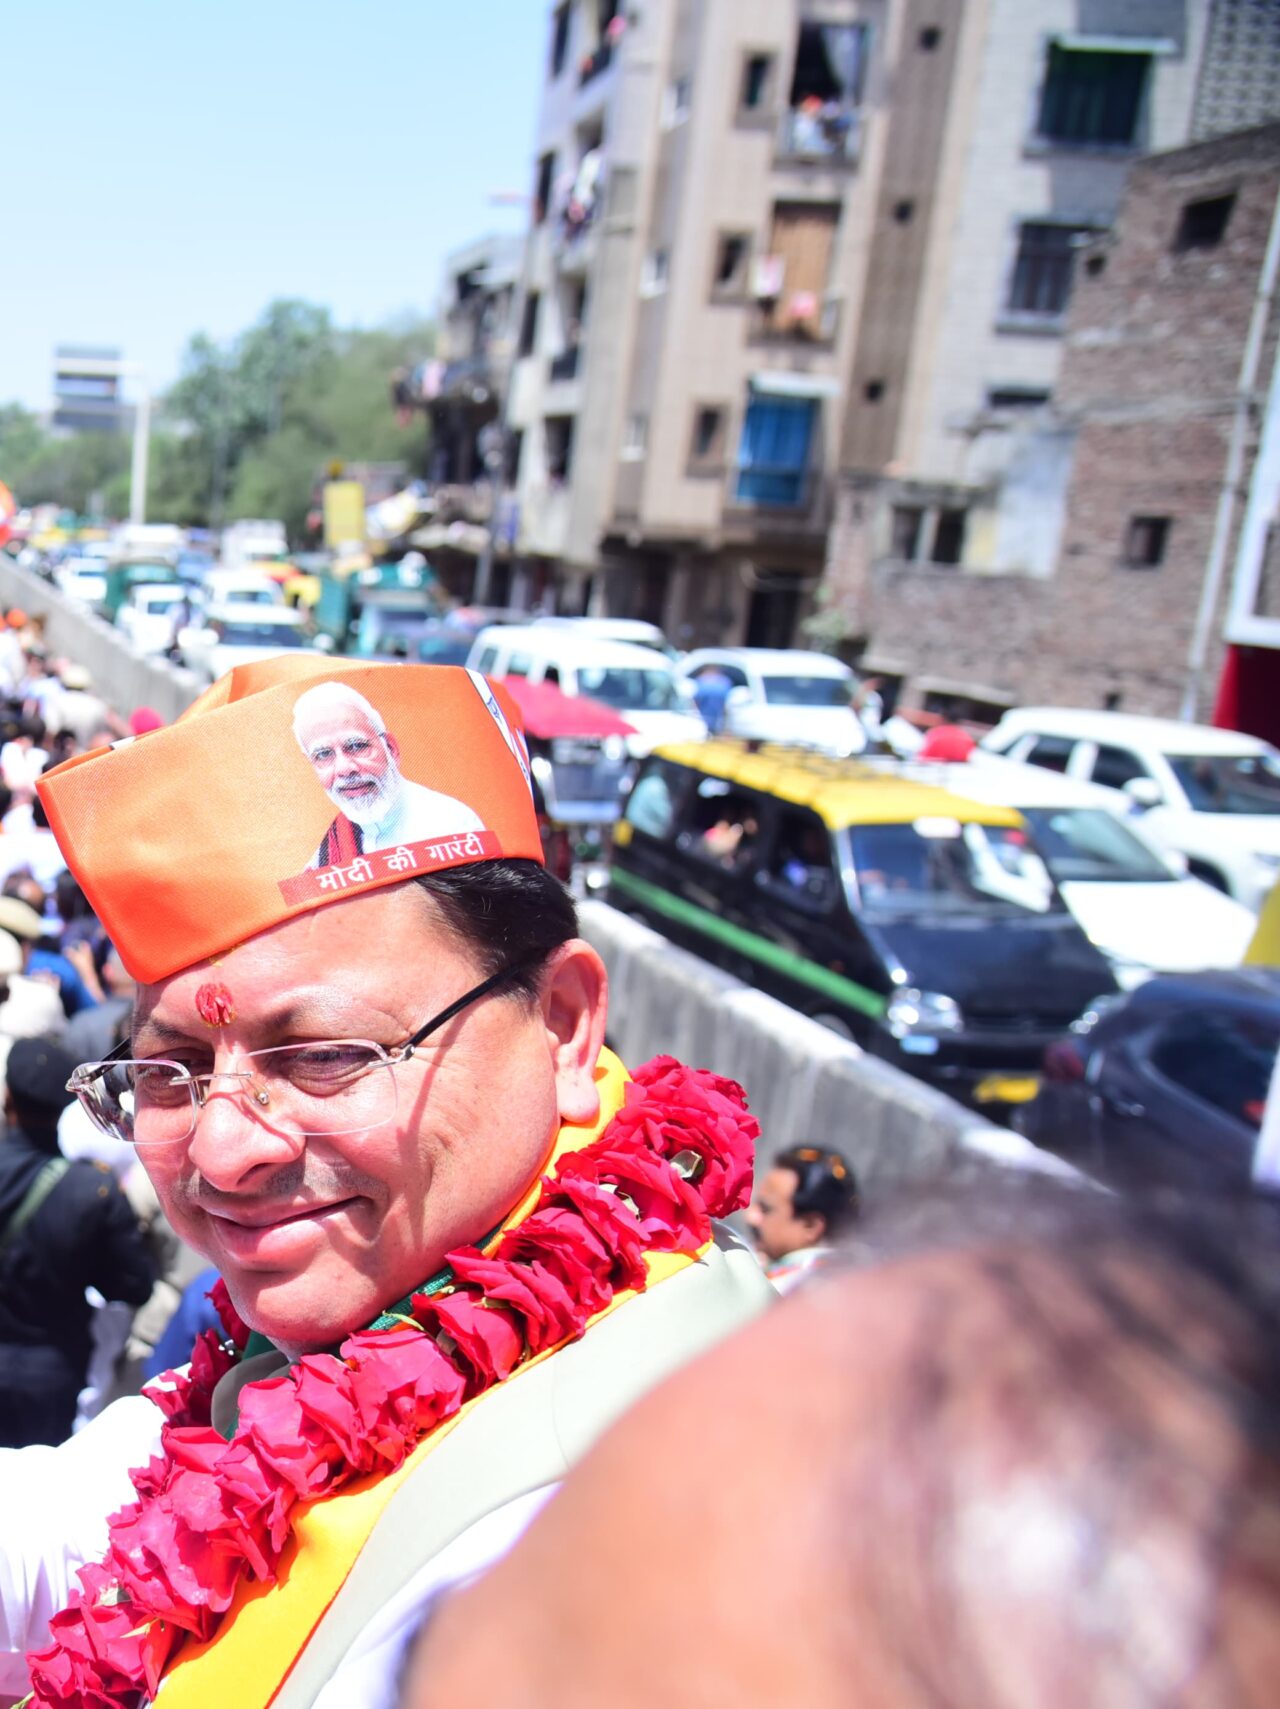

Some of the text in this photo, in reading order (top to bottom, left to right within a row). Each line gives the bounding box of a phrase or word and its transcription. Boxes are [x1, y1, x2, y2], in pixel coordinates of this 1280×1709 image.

[315, 832, 485, 890] मोदी की गारंटी
